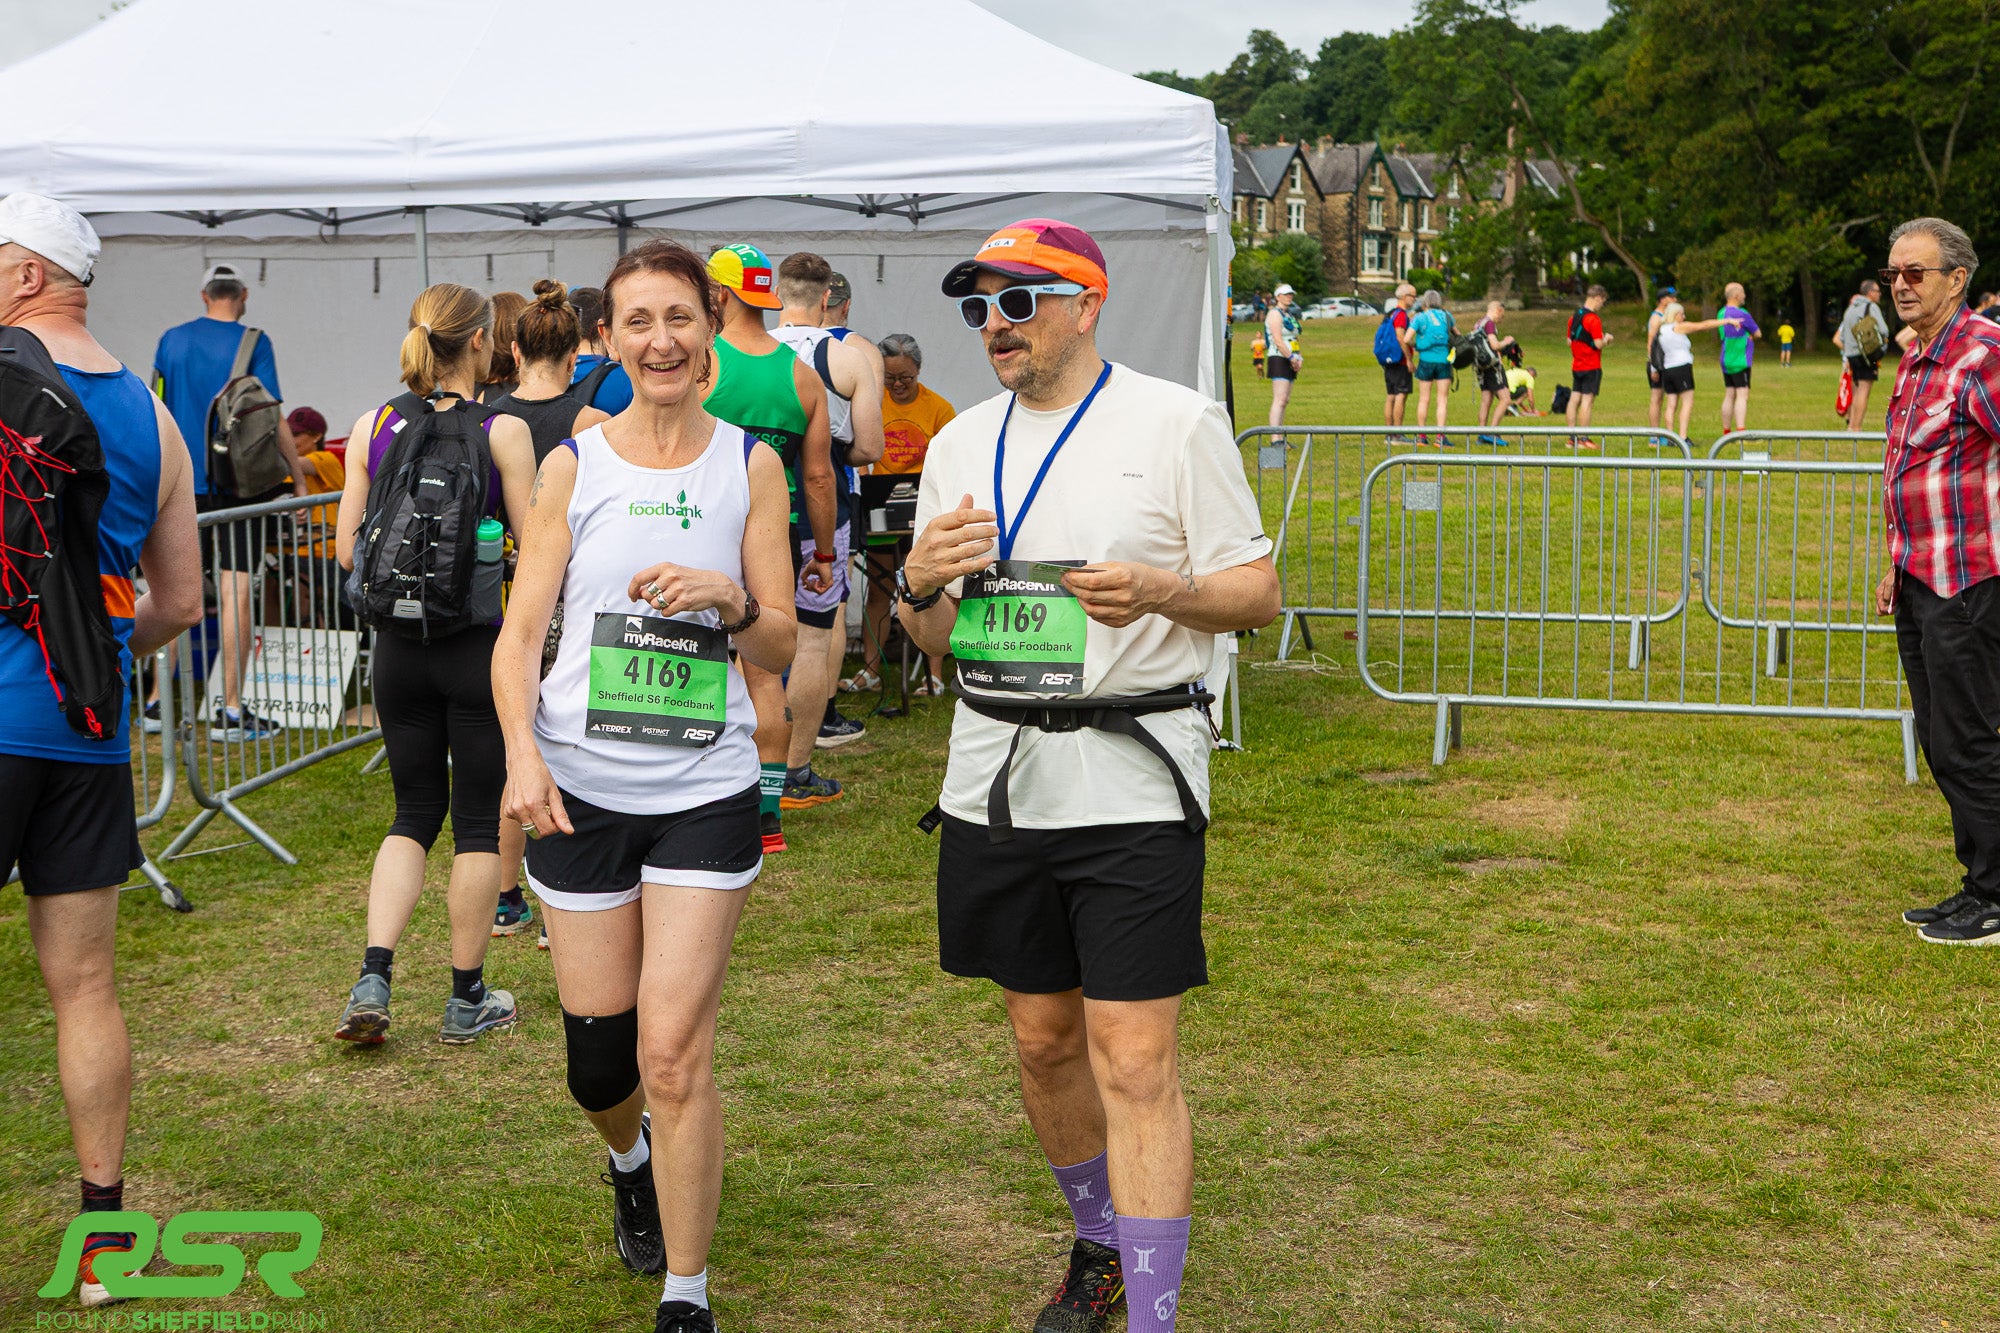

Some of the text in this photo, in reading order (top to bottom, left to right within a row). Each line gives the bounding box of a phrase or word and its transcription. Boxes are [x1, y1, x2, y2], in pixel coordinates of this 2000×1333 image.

[629, 502, 702, 519] foodbank
[984, 602, 1048, 633] 4169
[624, 632, 699, 653] myRaceKit
[959, 640, 1073, 652] Sheffield S6 Foodbank
[623, 655, 692, 690] 4169
[972, 671, 993, 683] TERREX
[1039, 673, 1074, 685] RSR
[213, 695, 332, 715] RISTRATION
[597, 690, 715, 711] Sheffield S6 Foodbank
[600, 723, 633, 735] TERREX
[682, 727, 716, 741] RSR
